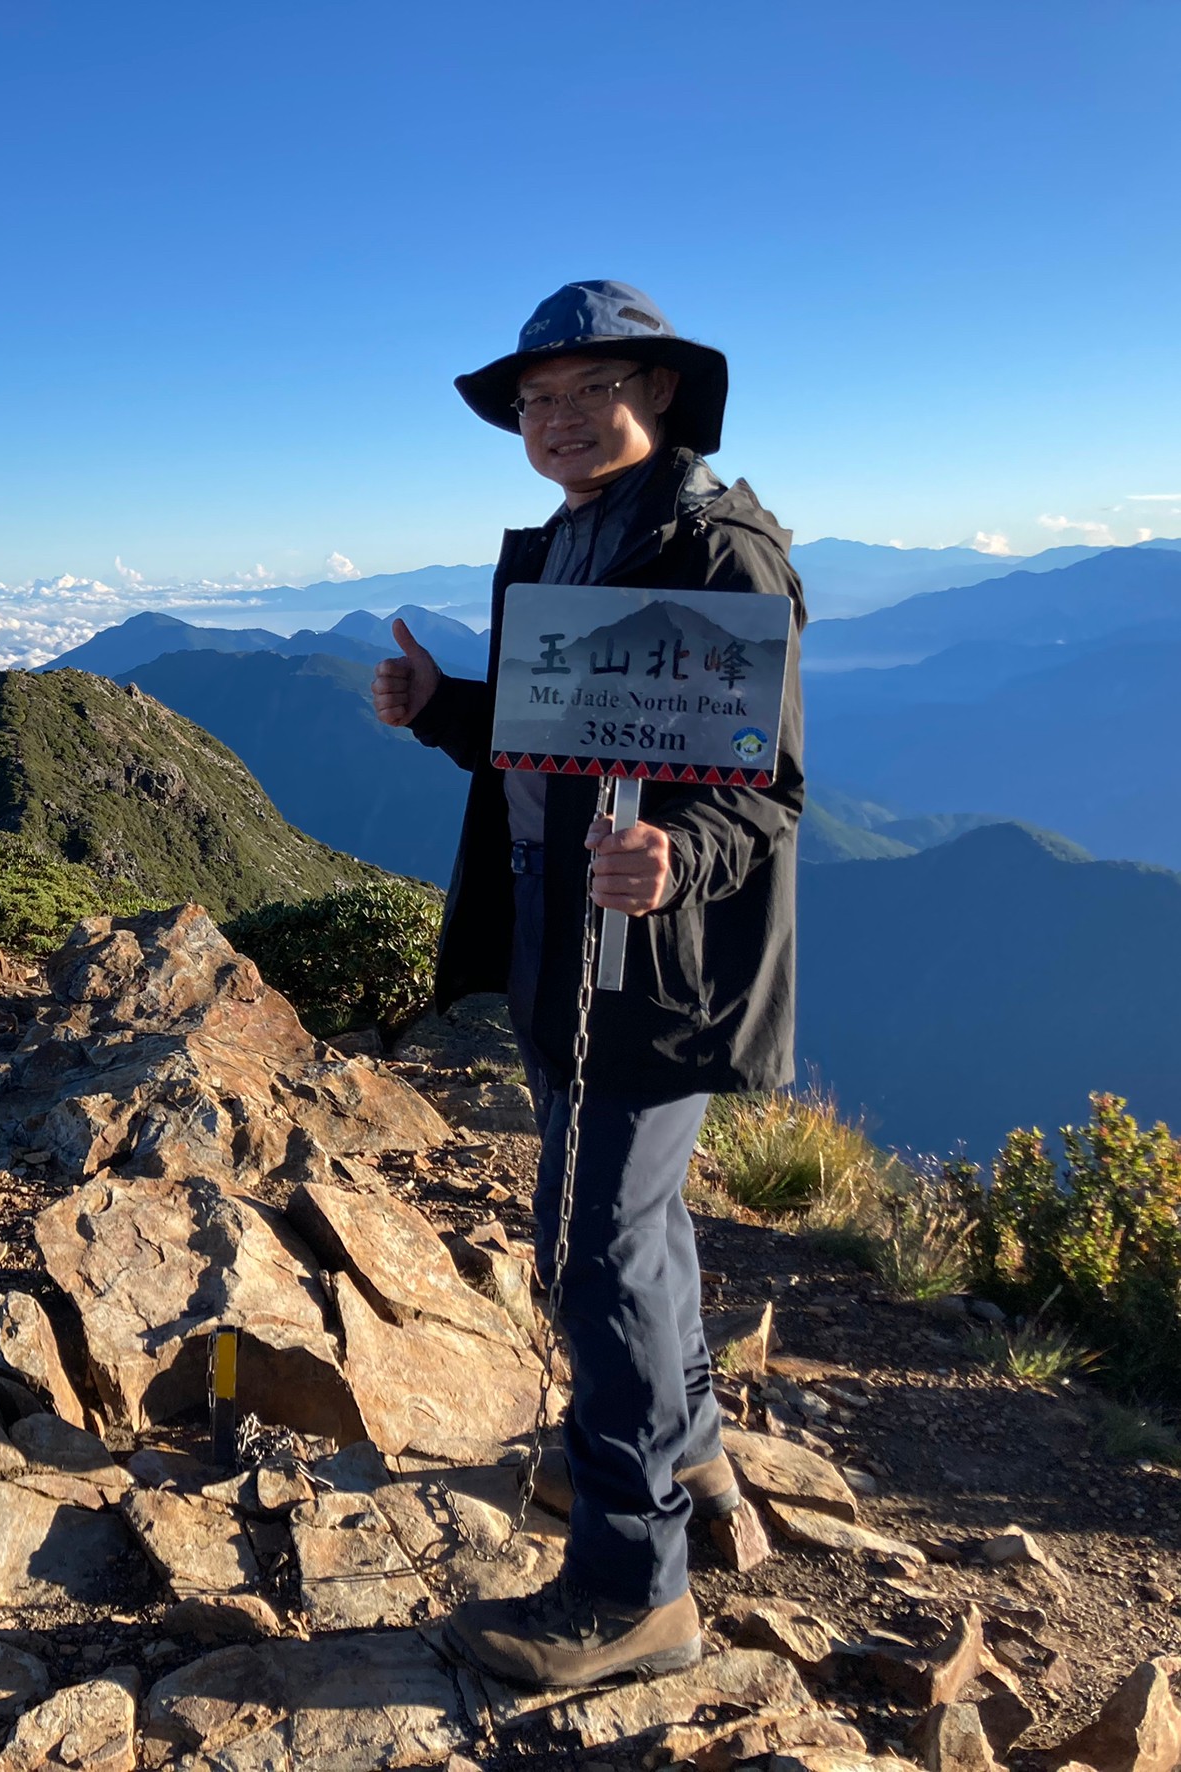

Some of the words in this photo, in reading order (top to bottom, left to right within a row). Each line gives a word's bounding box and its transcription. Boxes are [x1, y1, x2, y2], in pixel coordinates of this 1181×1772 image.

[531, 632, 754, 690] 玉山北峰
[528, 685, 565, 706] Mt.
[570, 687, 619, 709] Jade
[627, 691, 688, 714] North
[697, 695, 748, 717] Peak
[579, 720, 686, 751] 3858m
